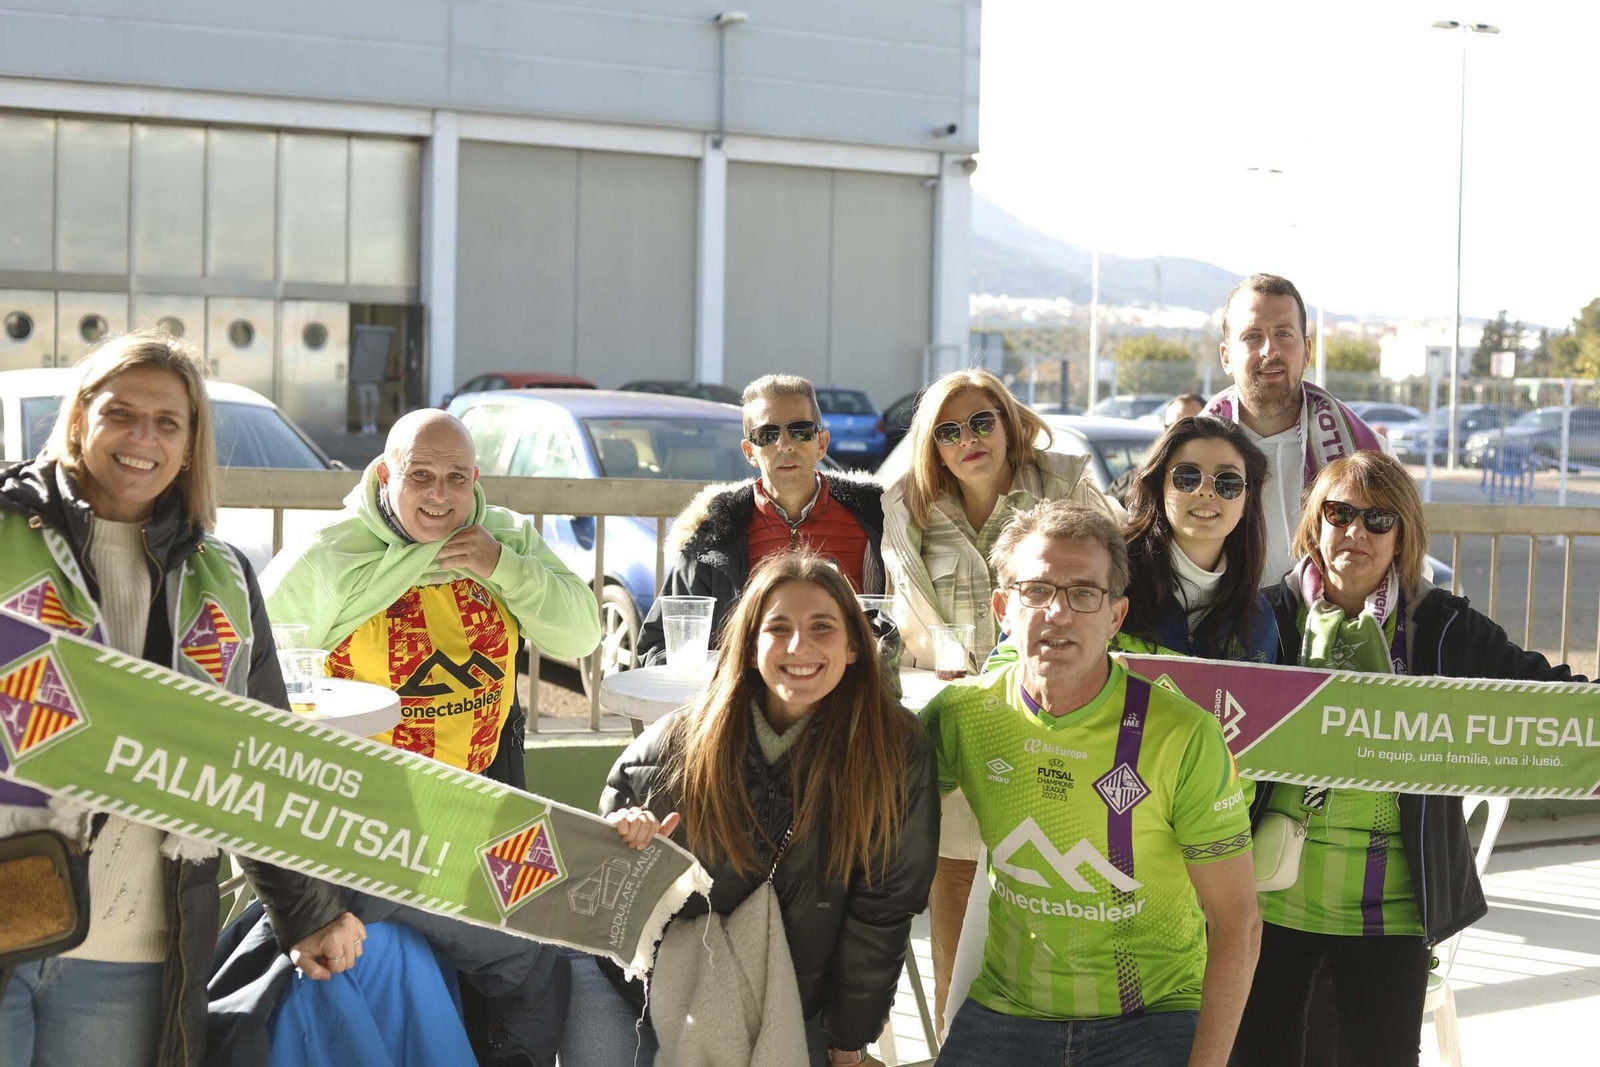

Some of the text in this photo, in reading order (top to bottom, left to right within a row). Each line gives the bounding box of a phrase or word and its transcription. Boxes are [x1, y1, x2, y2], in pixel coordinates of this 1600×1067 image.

[401, 686, 504, 719] onectabalear
[1123, 719, 1140, 728] IME
[1321, 705, 1600, 747] PALMA FUTSAL
[1357, 747, 1375, 758] Un
[1378, 750, 1416, 763] equip,
[1420, 753, 1443, 762] una
[1447, 752, 1491, 766] família,
[1495, 756, 1518, 765] una
[232, 736, 363, 799] ¡VAMOS
[1037, 767, 1074, 782] FUTSAL
[987, 774, 1010, 785] umbro
[1037, 777, 1074, 789] CHAMPIONS
[1041, 791, 1067, 802] 2022/23
[1042, 784, 1067, 795] LEAGUE
[105, 735, 450, 877] PALMA FUTSAL!
[609, 881, 634, 946] MODULAR
[631, 845, 656, 878] HAUS
[995, 881, 1146, 922] onectabalear
